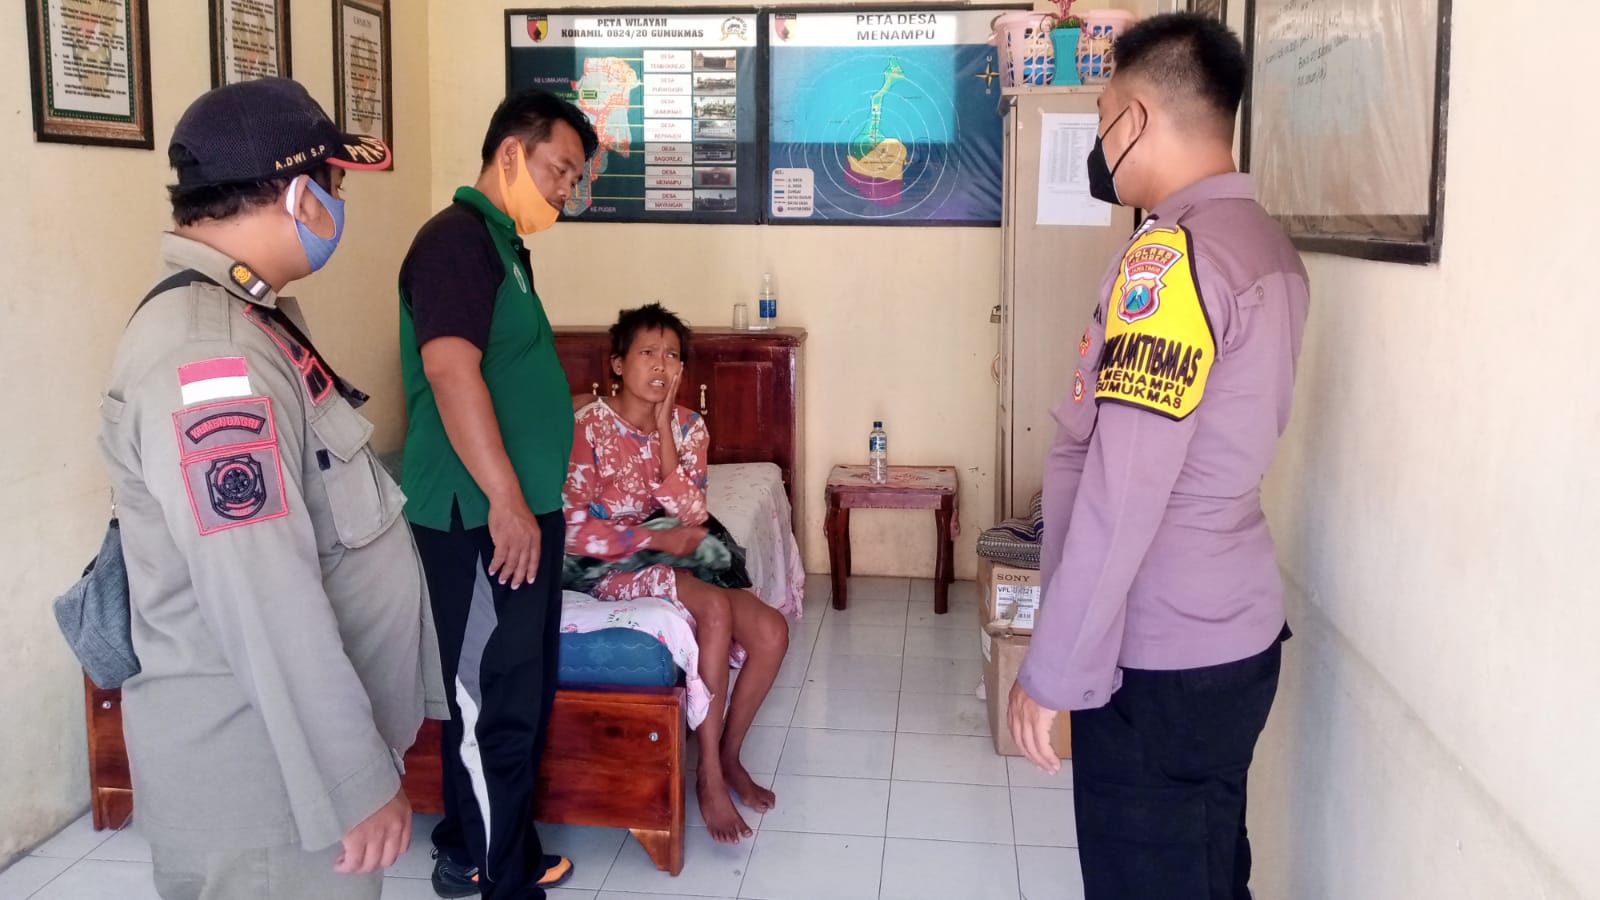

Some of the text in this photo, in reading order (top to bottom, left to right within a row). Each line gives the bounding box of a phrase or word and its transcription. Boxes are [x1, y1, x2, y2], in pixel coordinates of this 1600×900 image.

[597, 17, 668, 27] PETA WILAYAH
[856, 13, 937, 25] PETA DESA
[561, 29, 704, 39] KORAMIL 0824/20 GUMUKMAS
[857, 29, 935, 41] MENAMPU
[275, 152, 307, 170] A.DWI
[1103, 369, 1186, 396] MENAMPU
[1095, 380, 1183, 409] GUMUKMAS
[996, 573, 1031, 582] SONY
